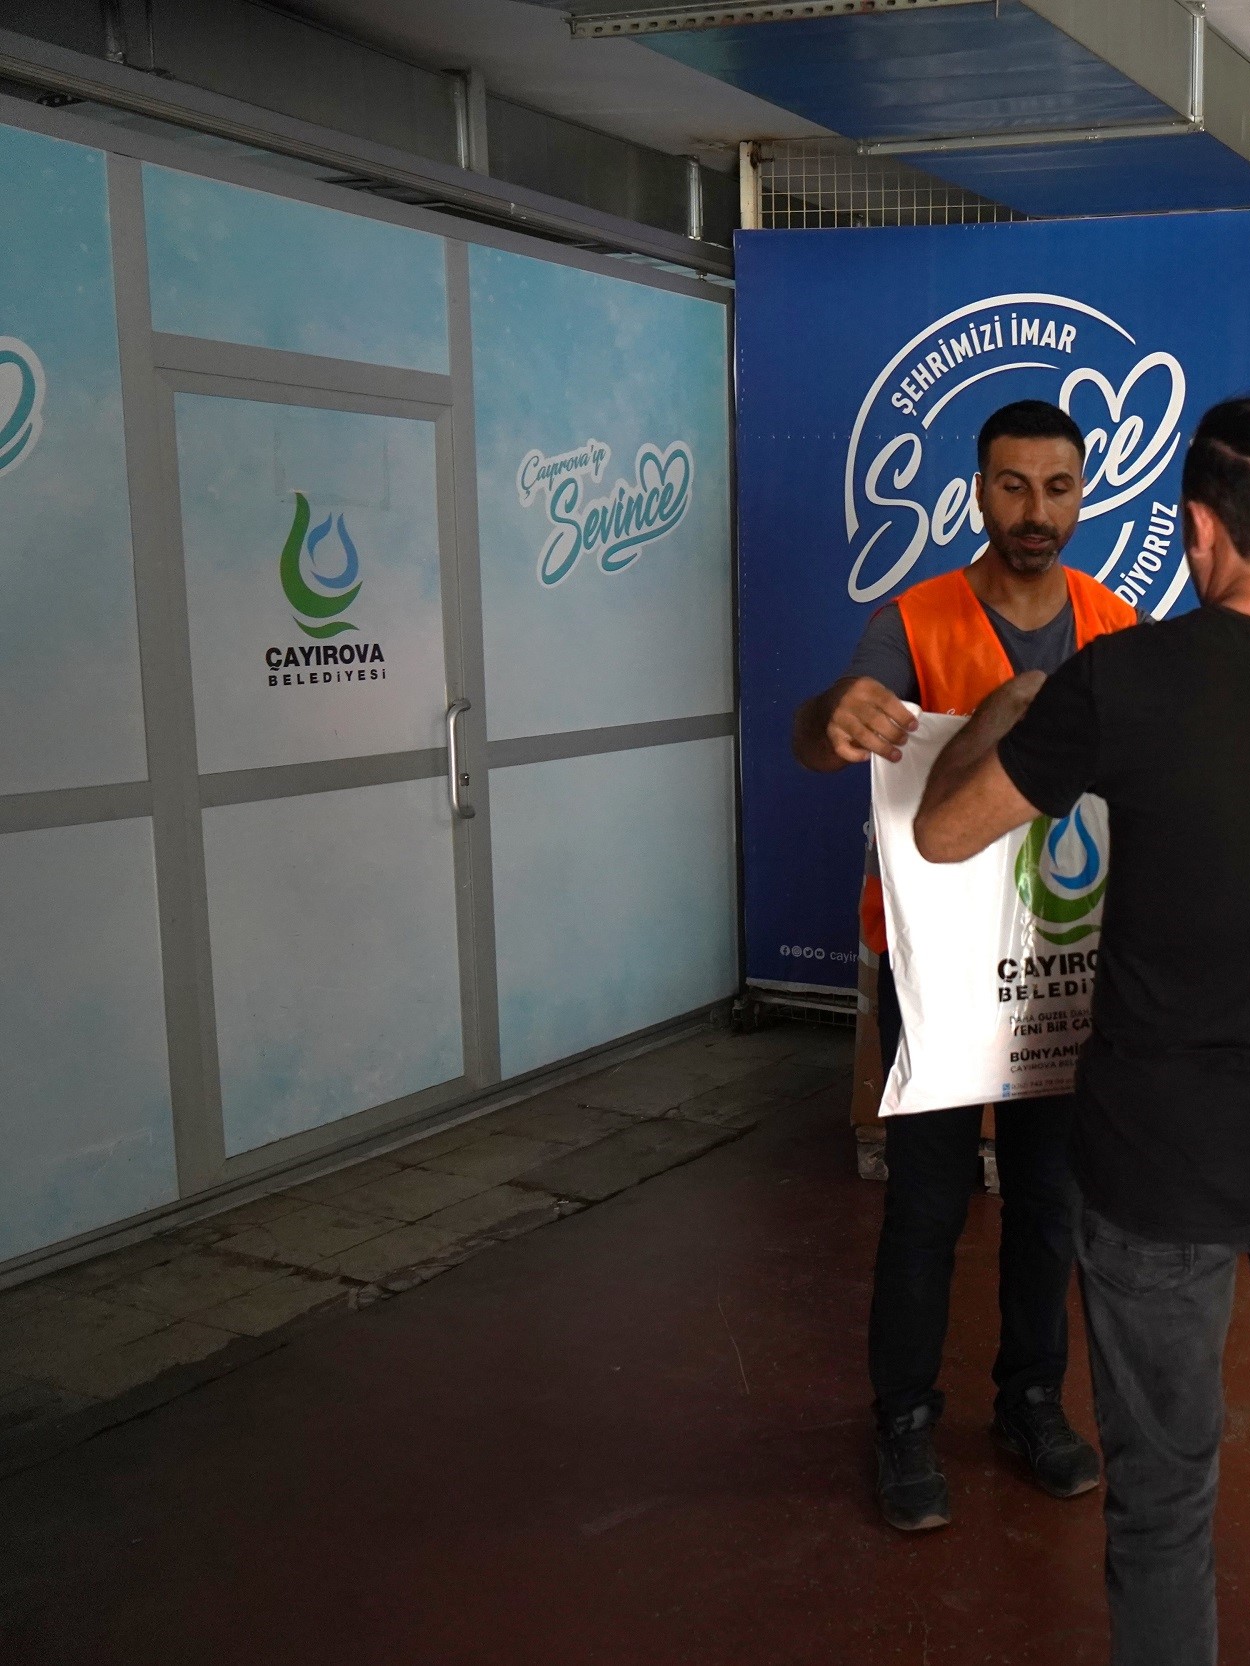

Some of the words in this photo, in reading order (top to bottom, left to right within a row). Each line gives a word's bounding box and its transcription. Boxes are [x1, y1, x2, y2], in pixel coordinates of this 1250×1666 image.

[891, 315, 1003, 416] ŞEHRİMİZİ
[1011, 312, 1077, 353] İMAR
[541, 464, 685, 585] Sevince
[265, 643, 385, 671] ÇAYIROVA
[268, 668, 386, 687] BELEDİYESİ
[829, 950, 859, 964] cayir
[998, 978, 1095, 1003] BELEDİ
